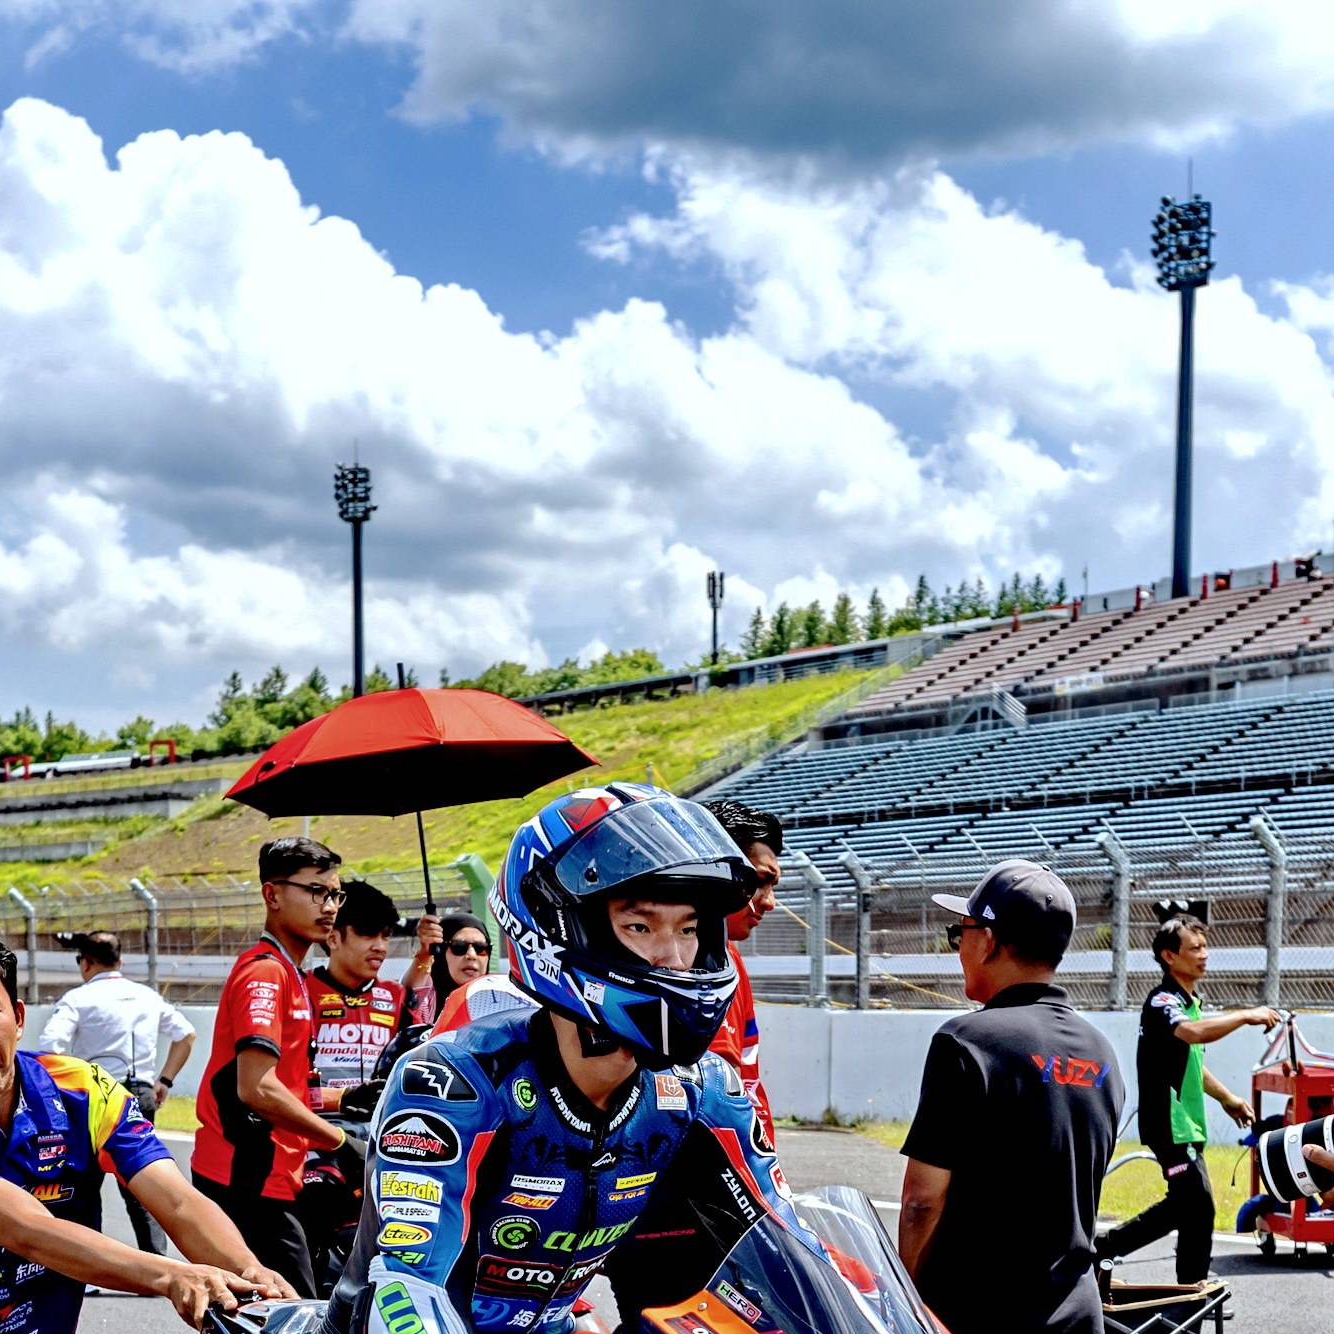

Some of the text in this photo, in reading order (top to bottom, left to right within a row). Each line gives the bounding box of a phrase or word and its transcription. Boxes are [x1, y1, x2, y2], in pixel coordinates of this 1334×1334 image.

[317, 1023, 390, 1045] MOTU
[1031, 1055, 1111, 1088] YUZY
[381, 1172, 440, 1201] Vesrah
[718, 1284, 758, 1318] HERO
